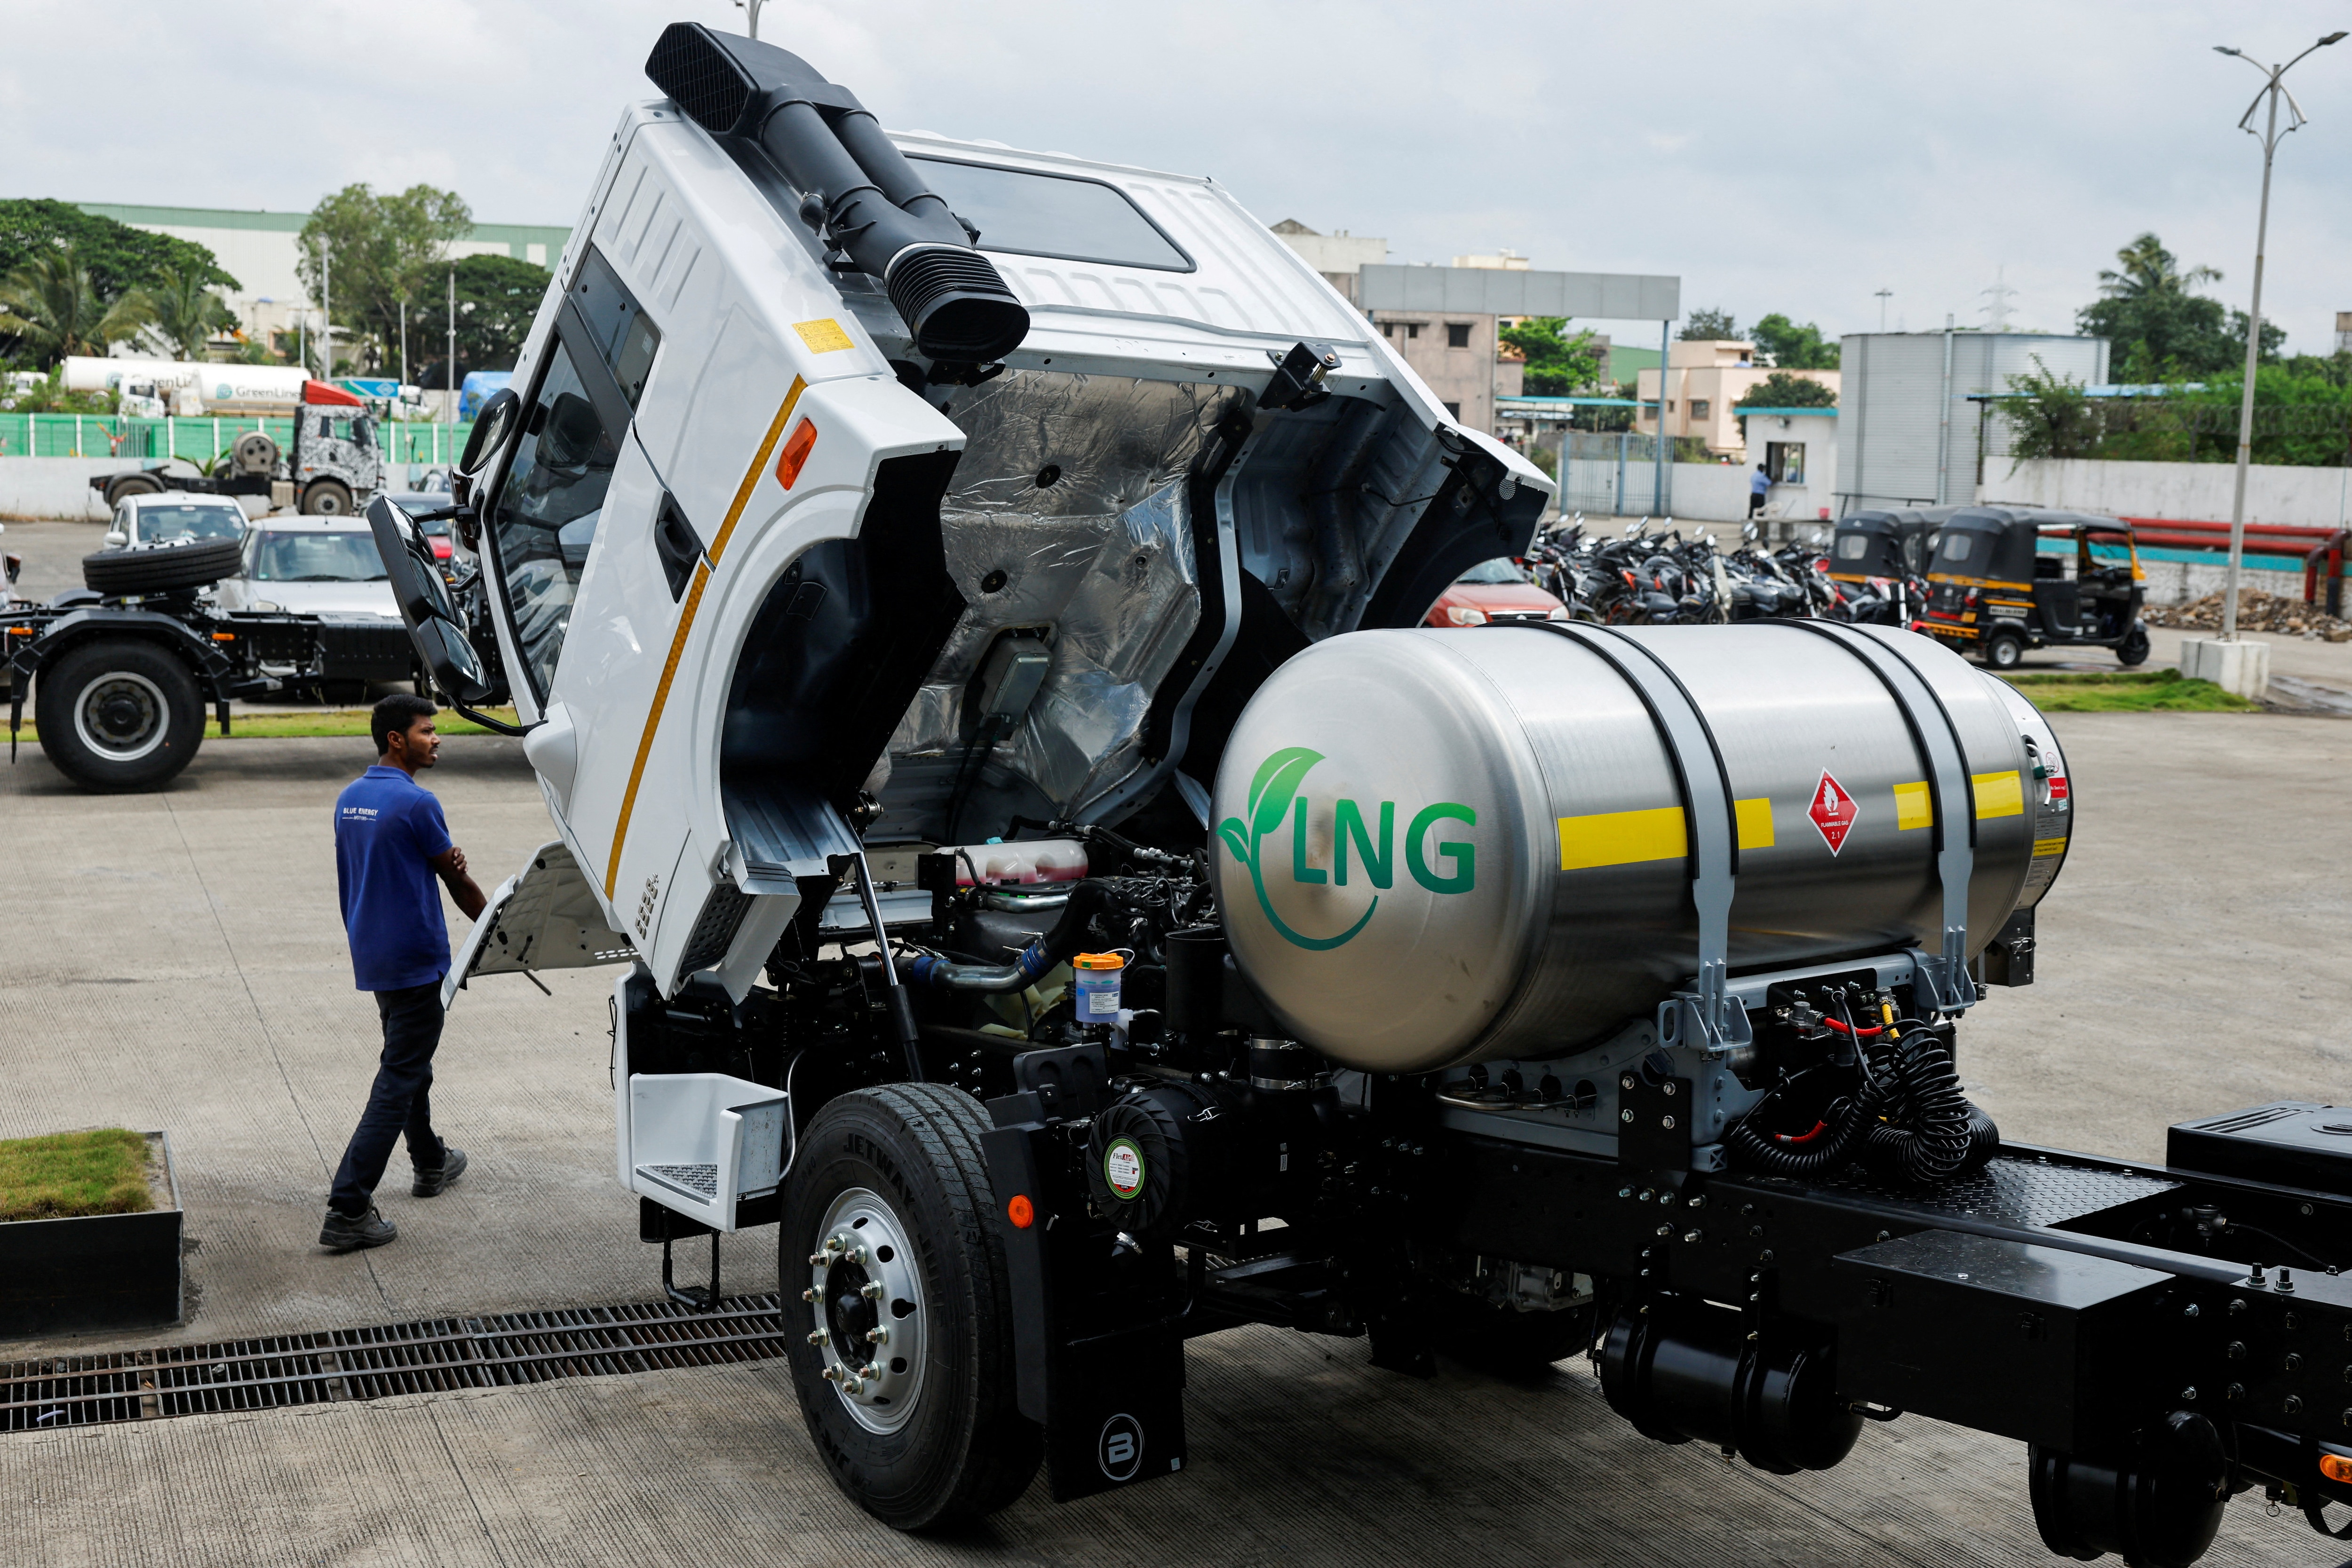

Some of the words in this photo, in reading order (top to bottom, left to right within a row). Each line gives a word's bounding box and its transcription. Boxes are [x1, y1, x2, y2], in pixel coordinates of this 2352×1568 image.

[236, 385, 301, 399] GreenLine
[358, 808, 378, 816] ENERGY
[1294, 797, 1476, 894] LNG
[1108, 1432, 1135, 1464] B
